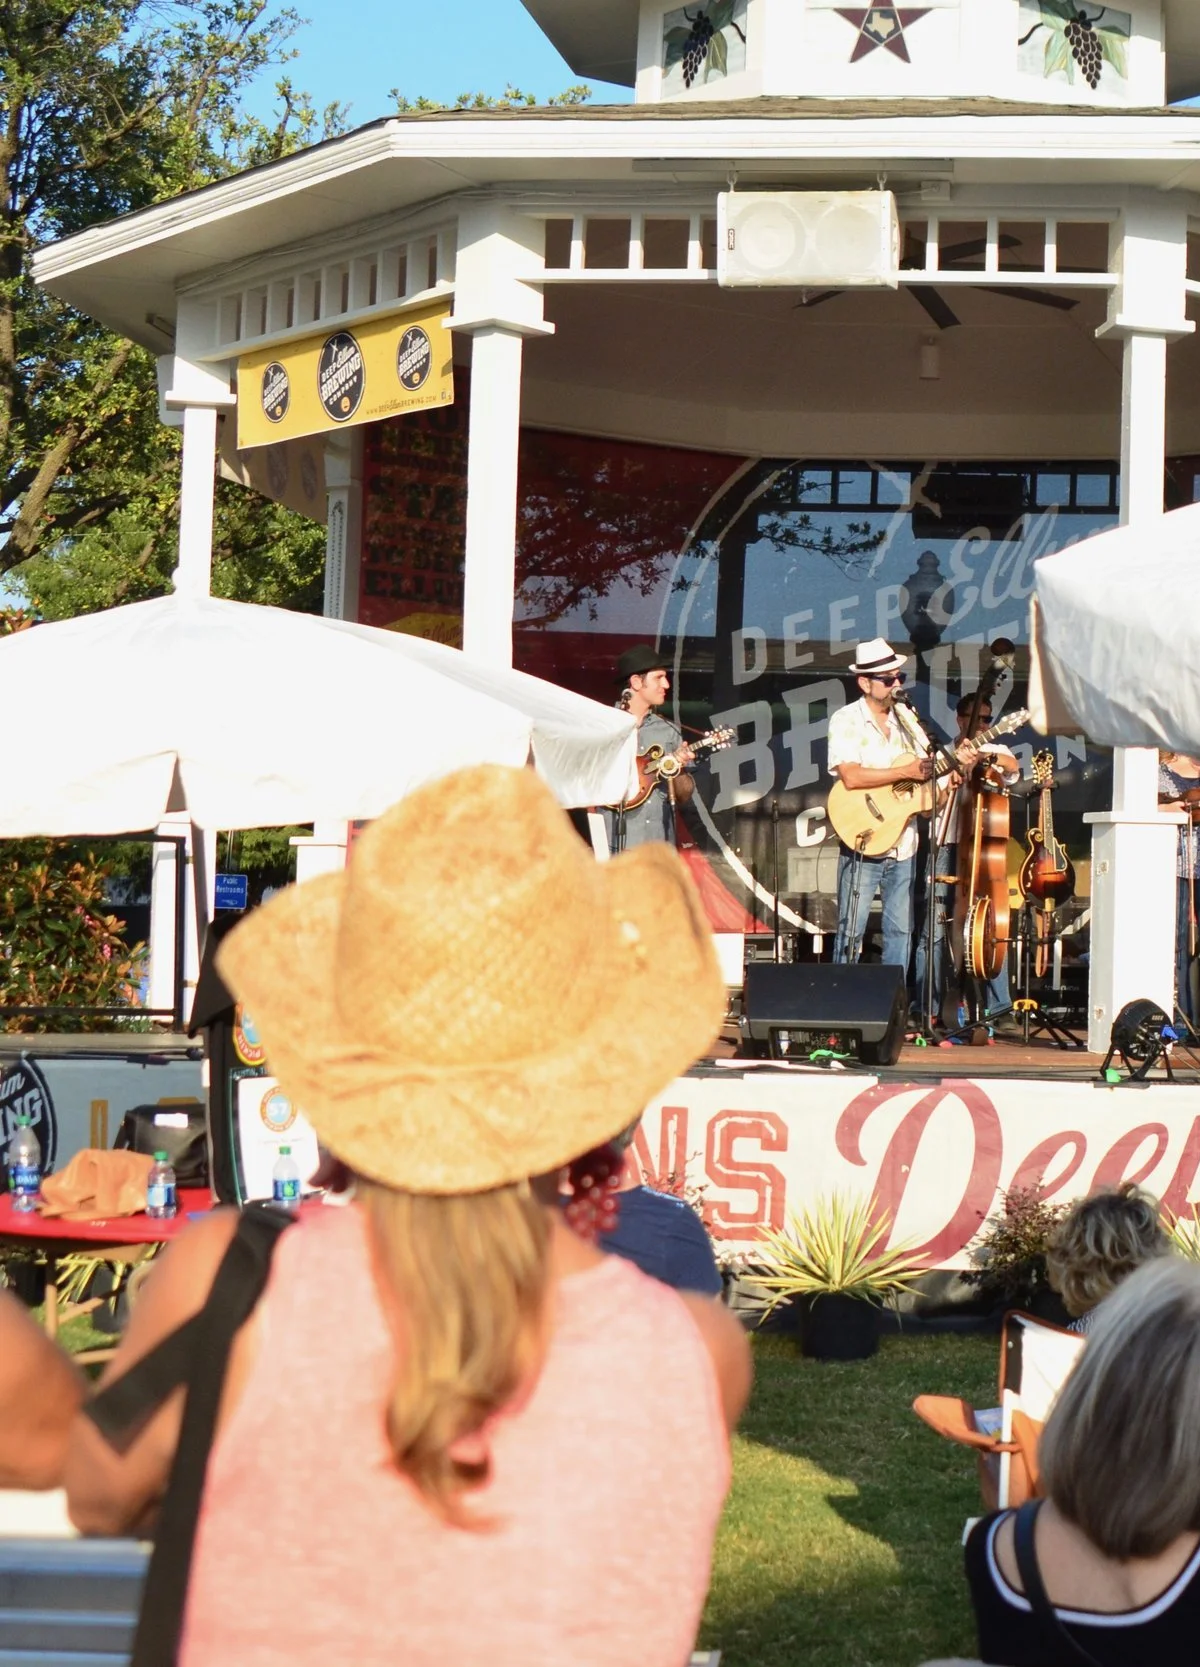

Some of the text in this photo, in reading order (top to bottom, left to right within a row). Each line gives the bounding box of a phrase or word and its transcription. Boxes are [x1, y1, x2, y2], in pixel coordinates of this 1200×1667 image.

[321, 362, 336, 382] DEEP
[321, 352, 361, 401] BREWING
[329, 375, 357, 405] COMPANY
[732, 584, 909, 686] DEEP
